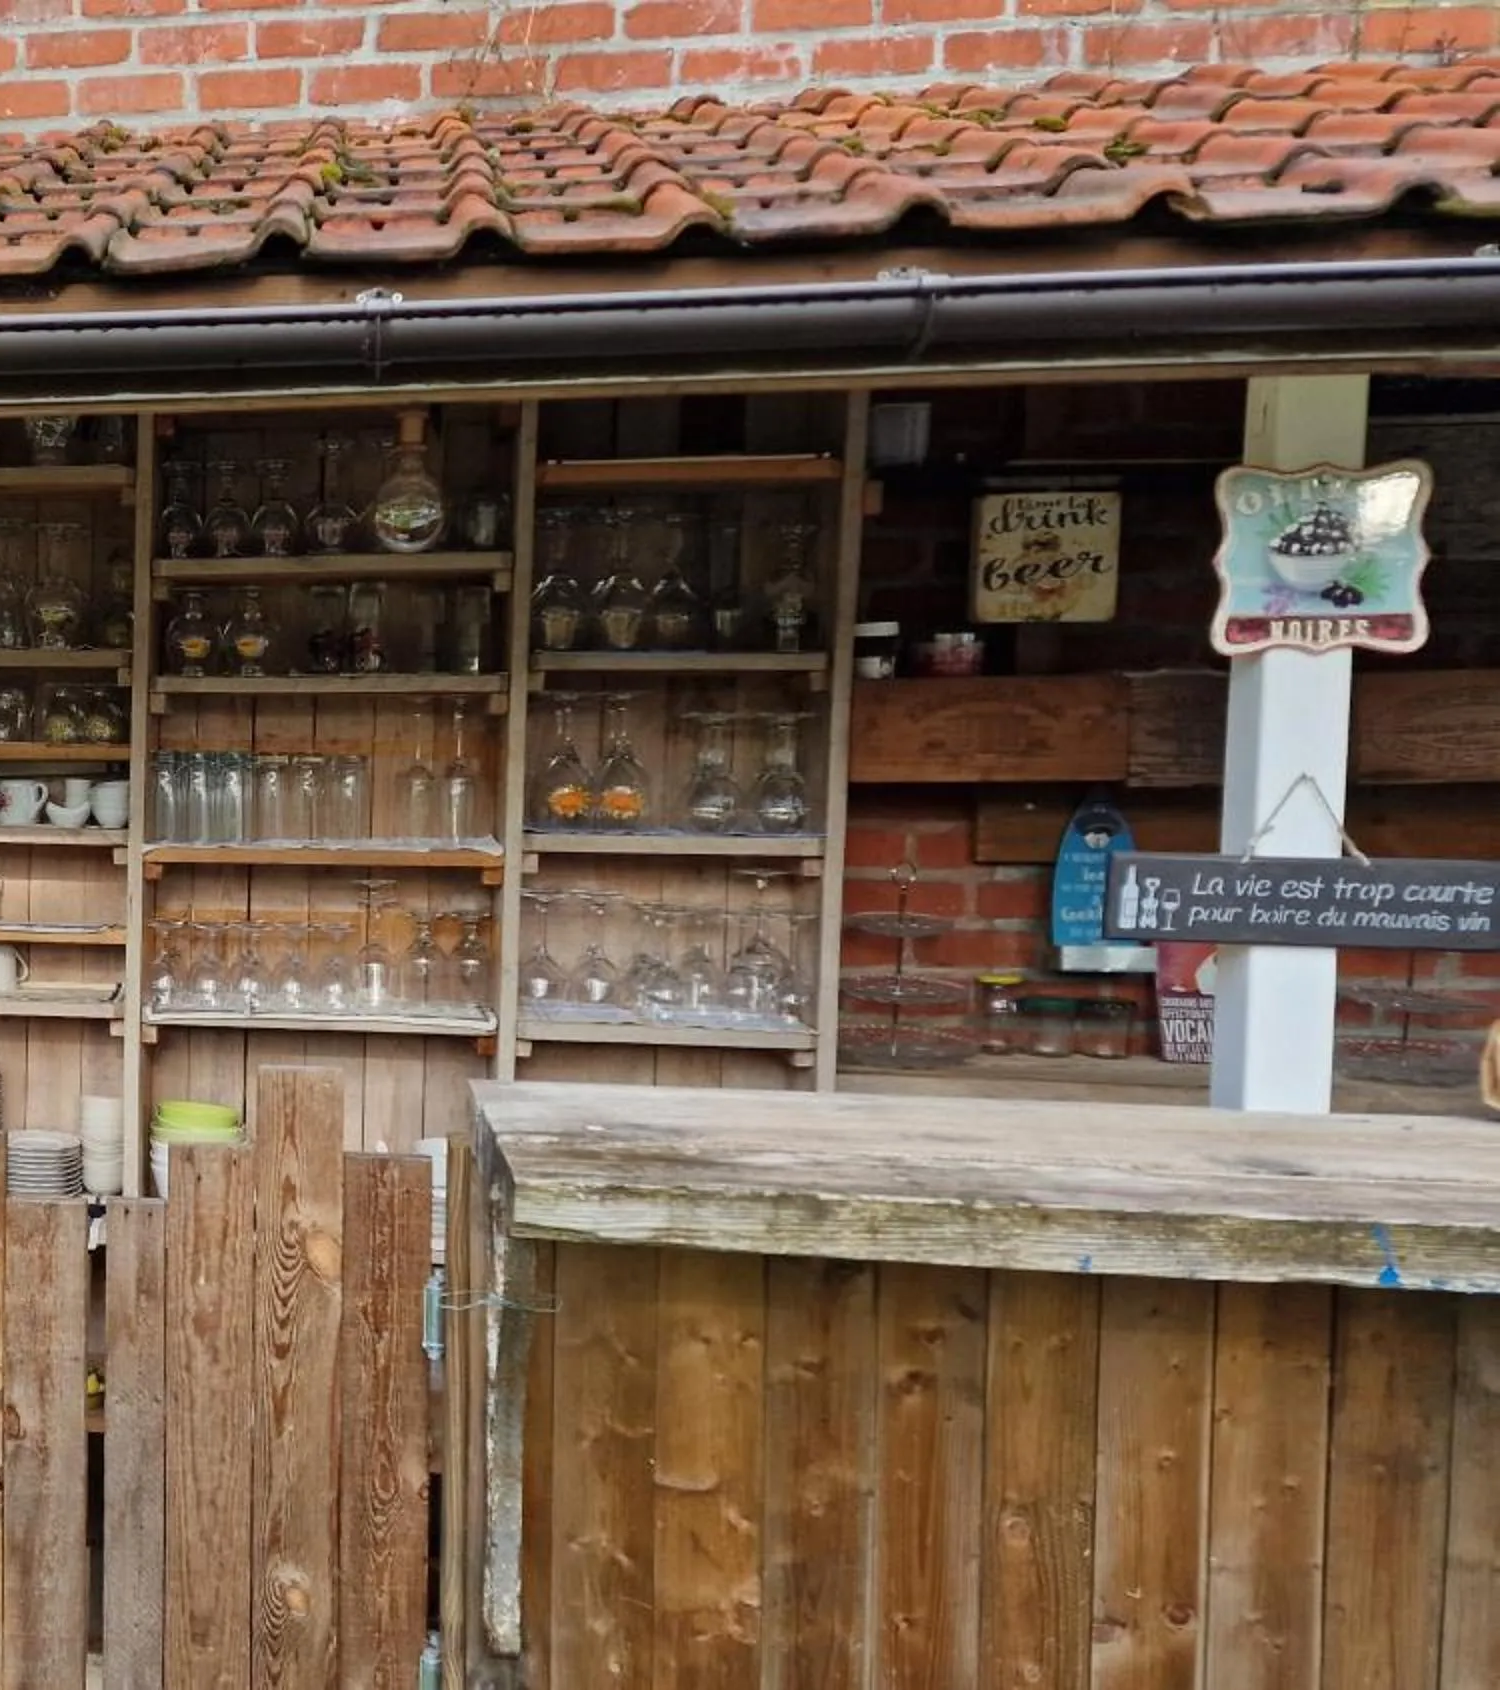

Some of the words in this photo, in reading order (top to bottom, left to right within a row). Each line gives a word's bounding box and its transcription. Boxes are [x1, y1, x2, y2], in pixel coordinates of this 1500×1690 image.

[988, 497, 1108, 534] drink
[982, 551, 1112, 593] beer
[1269, 619, 1372, 643] NOIRES
[1192, 873, 1225, 898] La
[1235, 874, 1273, 898] vie
[1280, 874, 1325, 900] est
[1333, 877, 1395, 907] trop
[1403, 881, 1495, 905] courte
[1188, 904, 1242, 926] pour
[1250, 904, 1312, 926] boire
[1317, 903, 1346, 927] du
[1352, 909, 1451, 931] mauvais
[1457, 911, 1491, 932] vin
